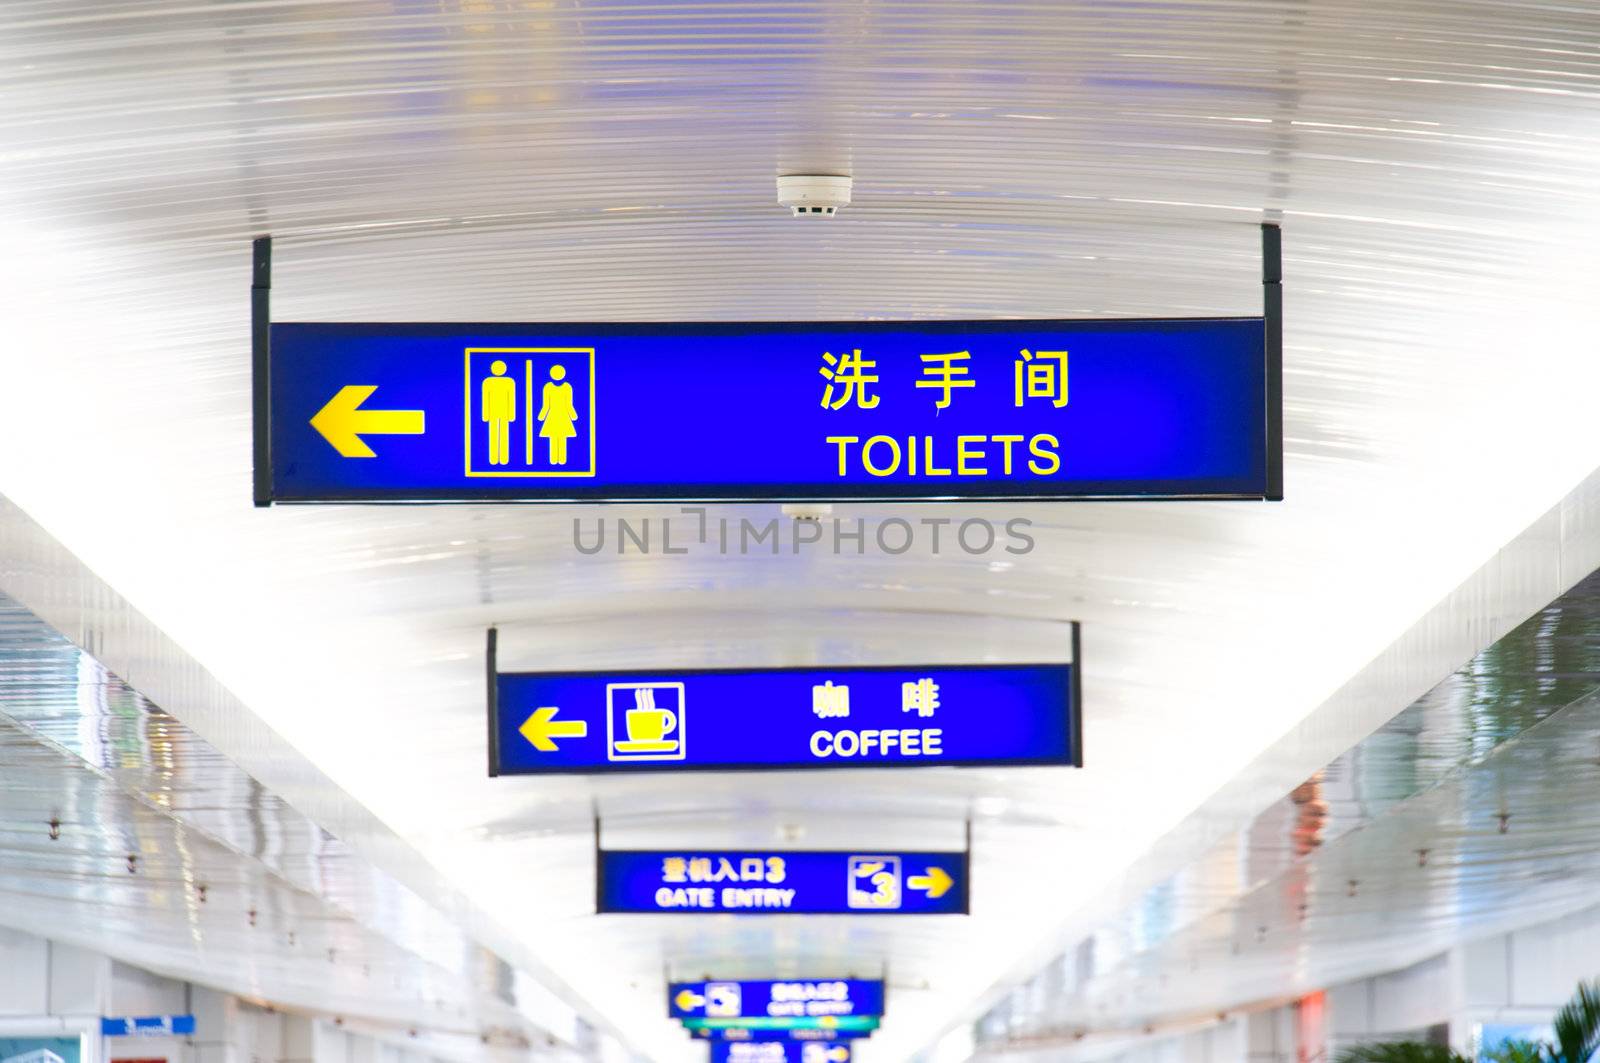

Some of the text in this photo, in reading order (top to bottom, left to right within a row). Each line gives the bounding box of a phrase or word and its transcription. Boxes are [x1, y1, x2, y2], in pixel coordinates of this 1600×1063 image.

[819, 349, 1068, 410] 洗手间
[826, 434, 1061, 476] TOILETS
[810, 729, 943, 757] COFFEE
[655, 888, 796, 907] GATE ENTRY
